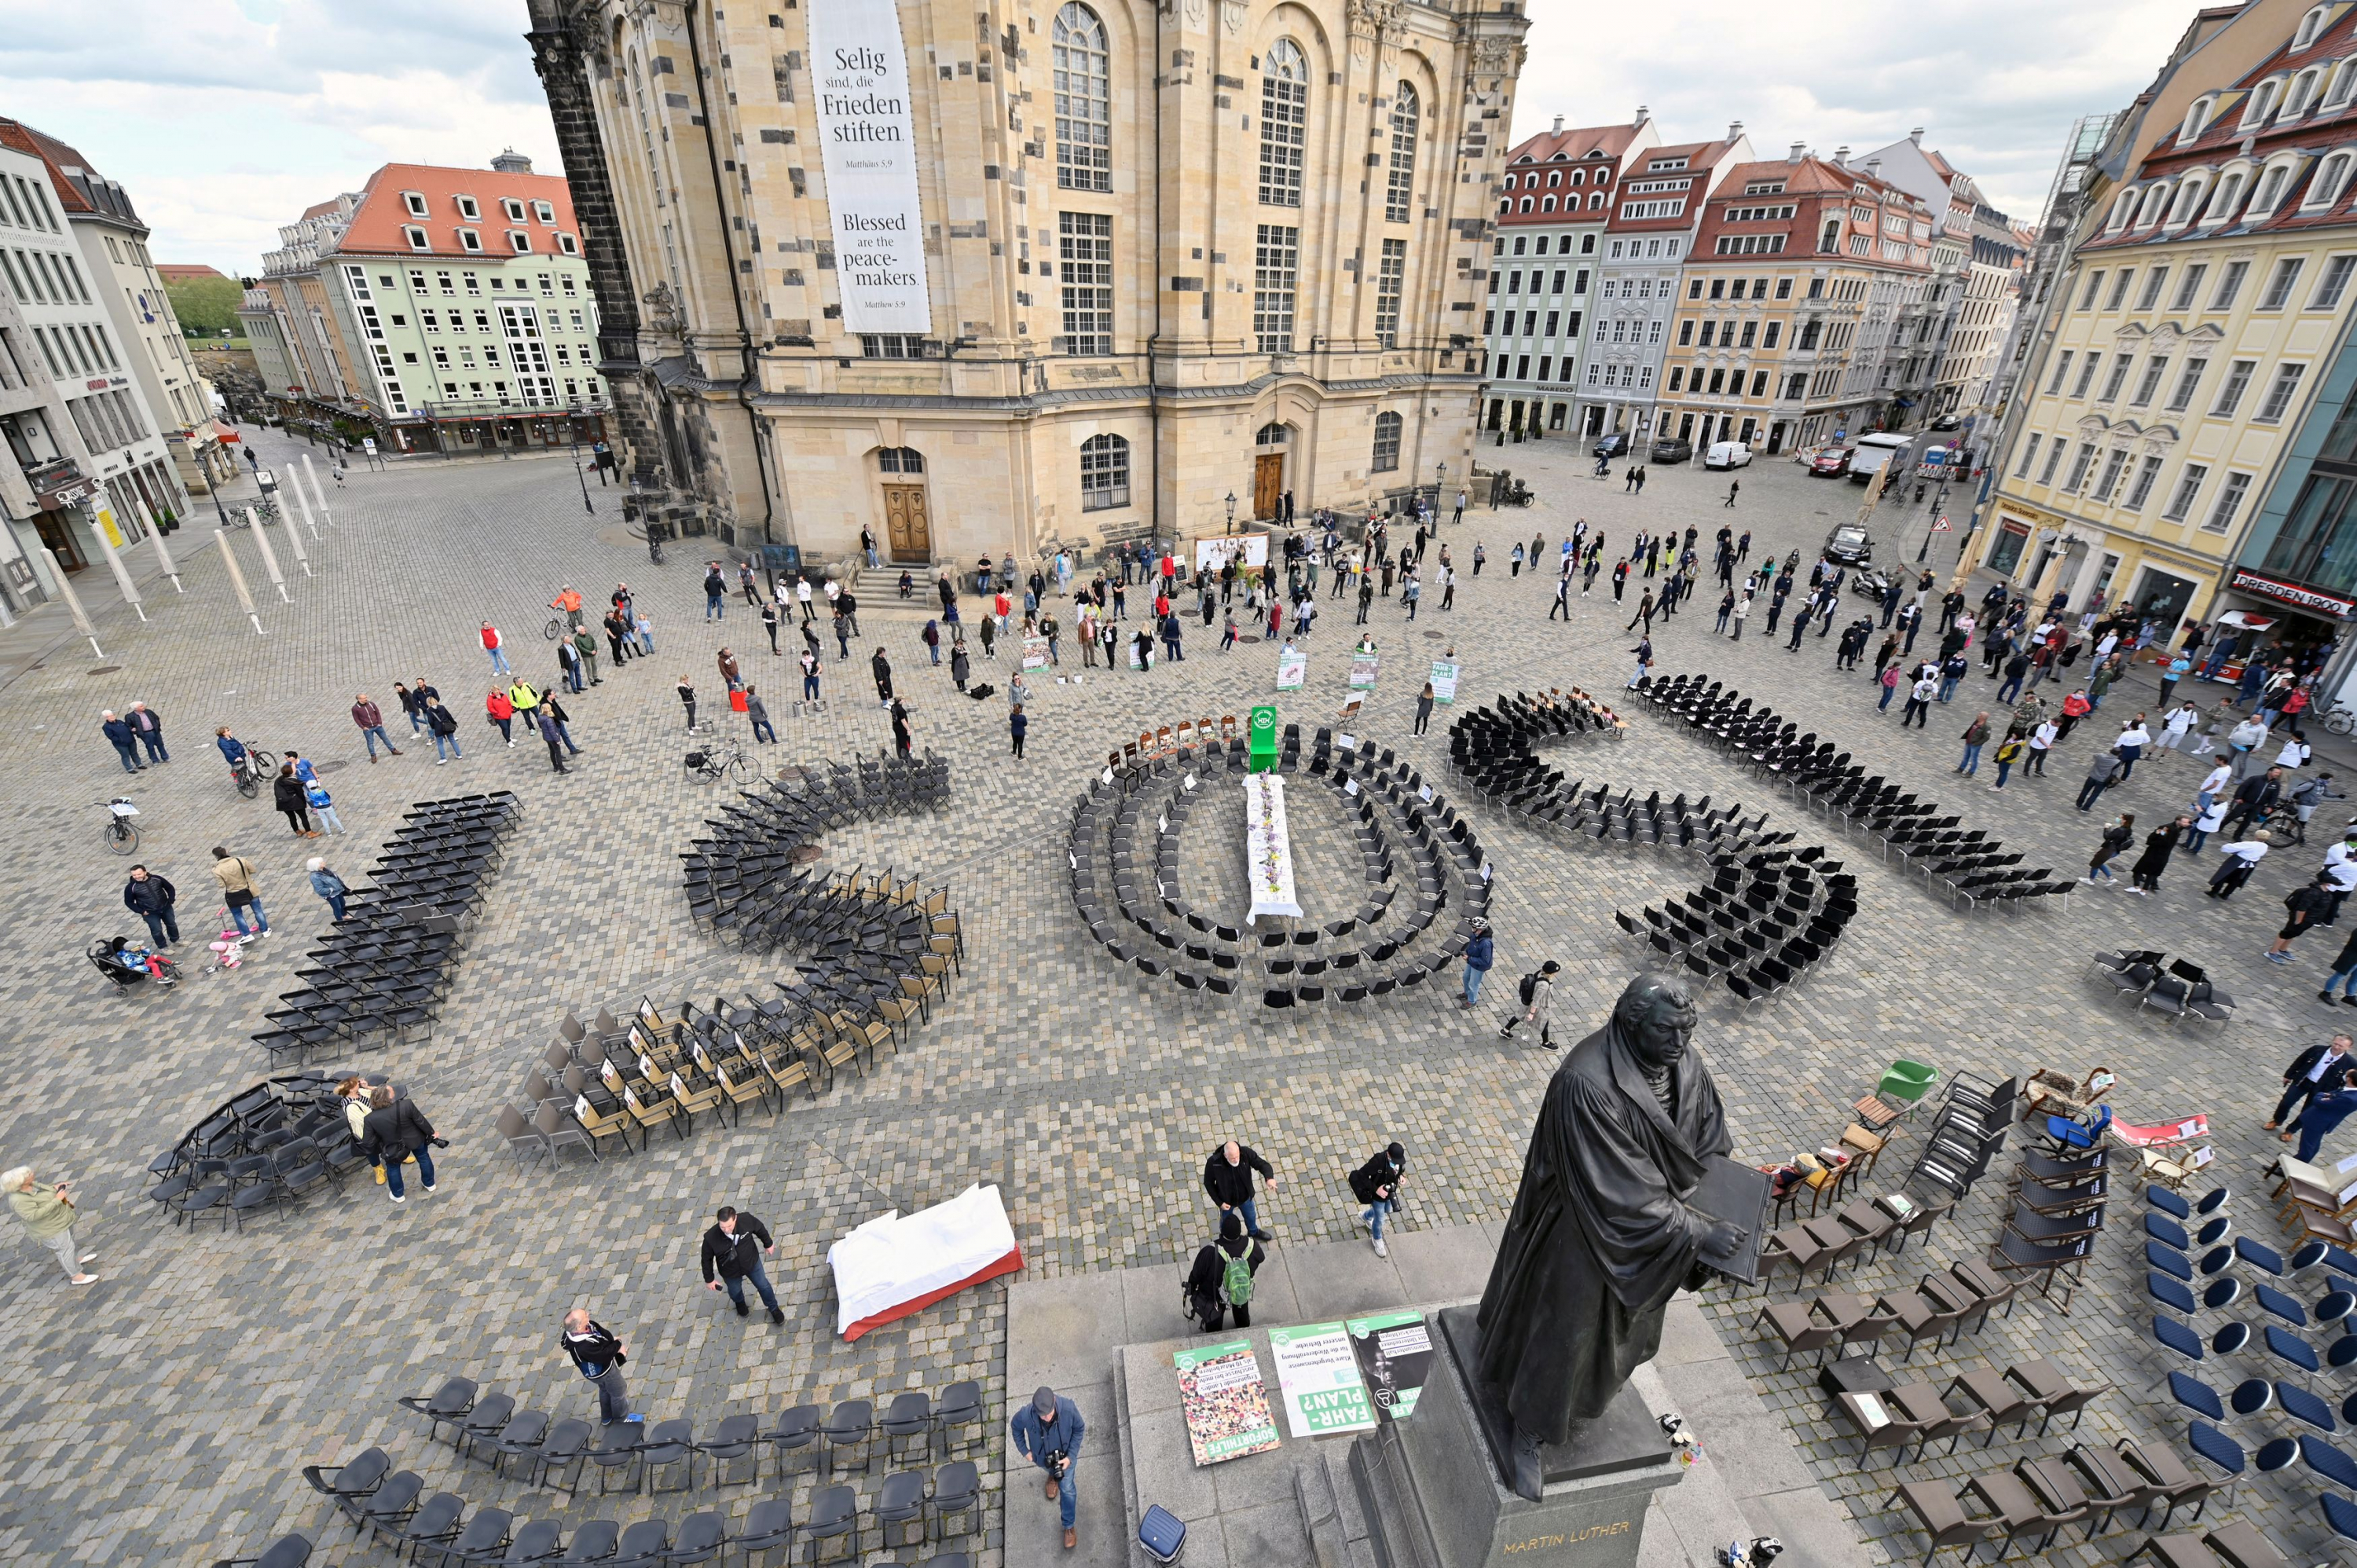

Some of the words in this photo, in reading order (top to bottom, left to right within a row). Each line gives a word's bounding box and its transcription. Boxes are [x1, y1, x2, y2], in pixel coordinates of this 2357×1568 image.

[835, 47, 886, 75] Selig
[826, 78, 852, 90] sind,
[856, 75, 874, 87] die
[823, 93, 902, 115] Frieden
[834, 122, 905, 142] stiften.
[845, 159, 879, 168] Matthäus
[881, 159, 893, 168] 5,9
[843, 213, 907, 232] Blessed
[857, 238, 874, 247] are
[876, 236, 894, 247] the
[844, 252, 897, 271] peace-
[856, 269, 920, 287] makers.
[865, 300, 893, 309] Matthew
[895, 300, 906, 309] 5:9
[2079, 446, 2103, 500] APART
[2110, 453, 2137, 509] HOTEL
[2239, 577, 2305, 603] DRESDEN
[2306, 595, 2341, 613] 1900
[1281, 1350, 1329, 1360] Wiedereröffnung
[1386, 1343, 1432, 1356] Lebensunterhalt
[1288, 1358, 1336, 1369] Vorgehensweise
[1303, 1388, 1364, 1411] PLAN?
[1311, 1405, 1370, 1427] FAHR-
[1208, 1428, 1275, 1454] SOFORTHILFE
[1504, 1533, 1564, 1555] MARTIN
[1570, 1521, 1629, 1542] LUTHER
